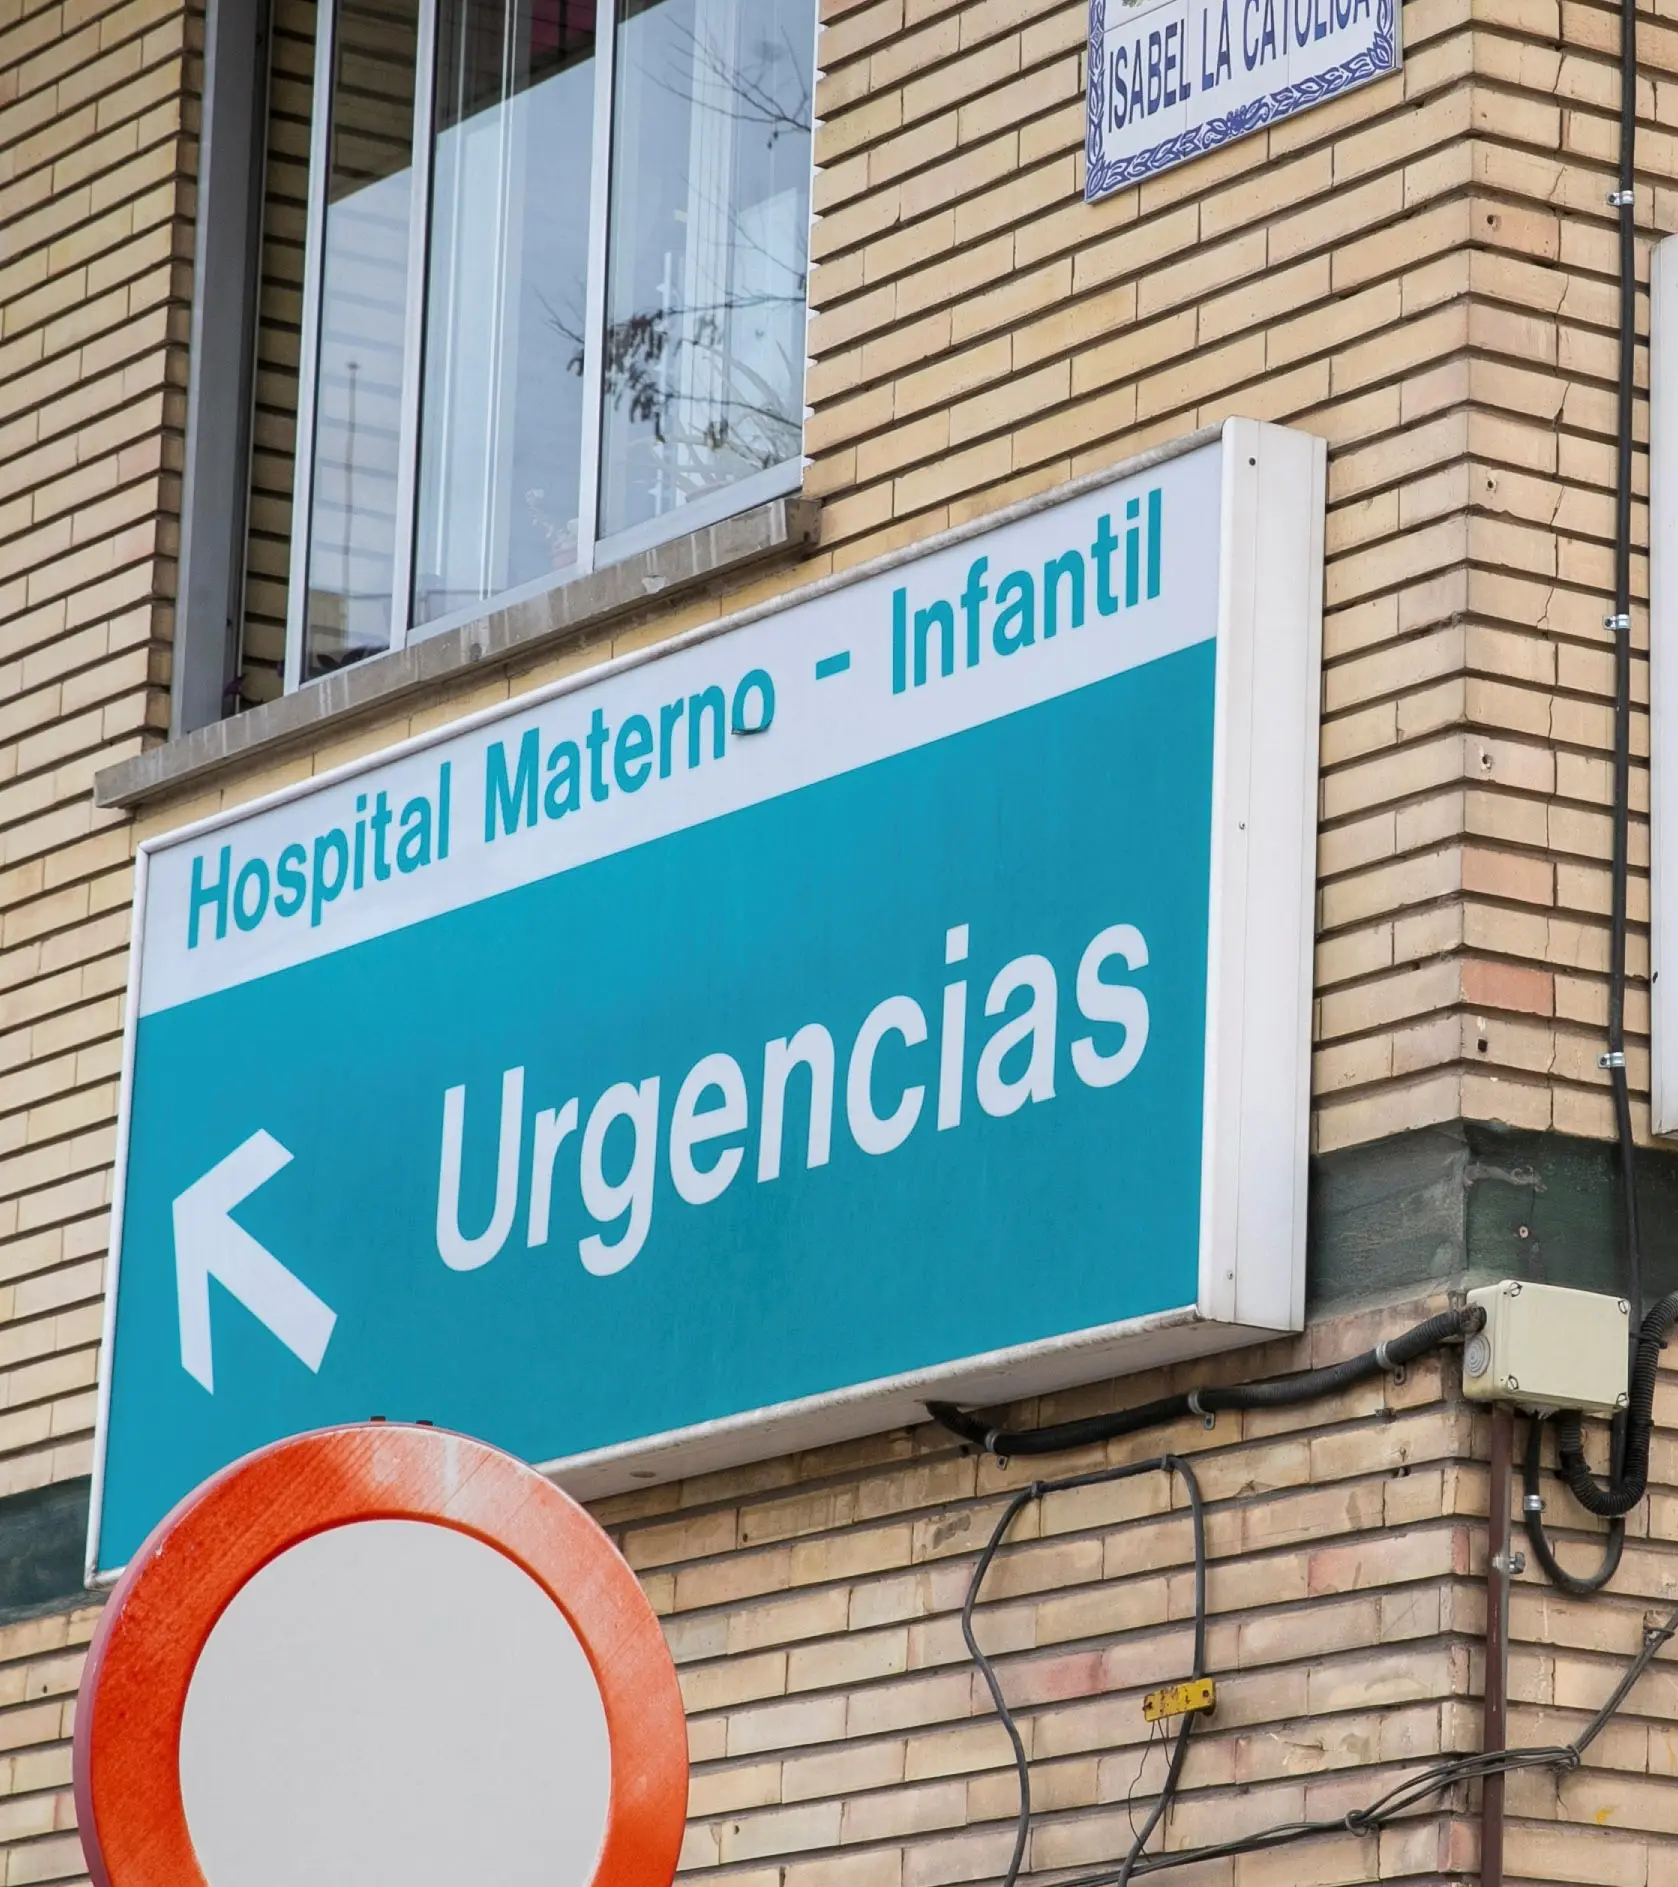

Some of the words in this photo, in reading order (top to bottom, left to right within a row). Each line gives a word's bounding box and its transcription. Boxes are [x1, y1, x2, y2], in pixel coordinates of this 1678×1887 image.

[1109, 19, 1191, 134] ISABEL
[1202, 0, 1231, 91] LA
[187, 760, 452, 950] Hospital
[484, 668, 776, 844] Materno
[891, 487, 1162, 696] Infantil
[436, 923, 1150, 1277] Urgencias
